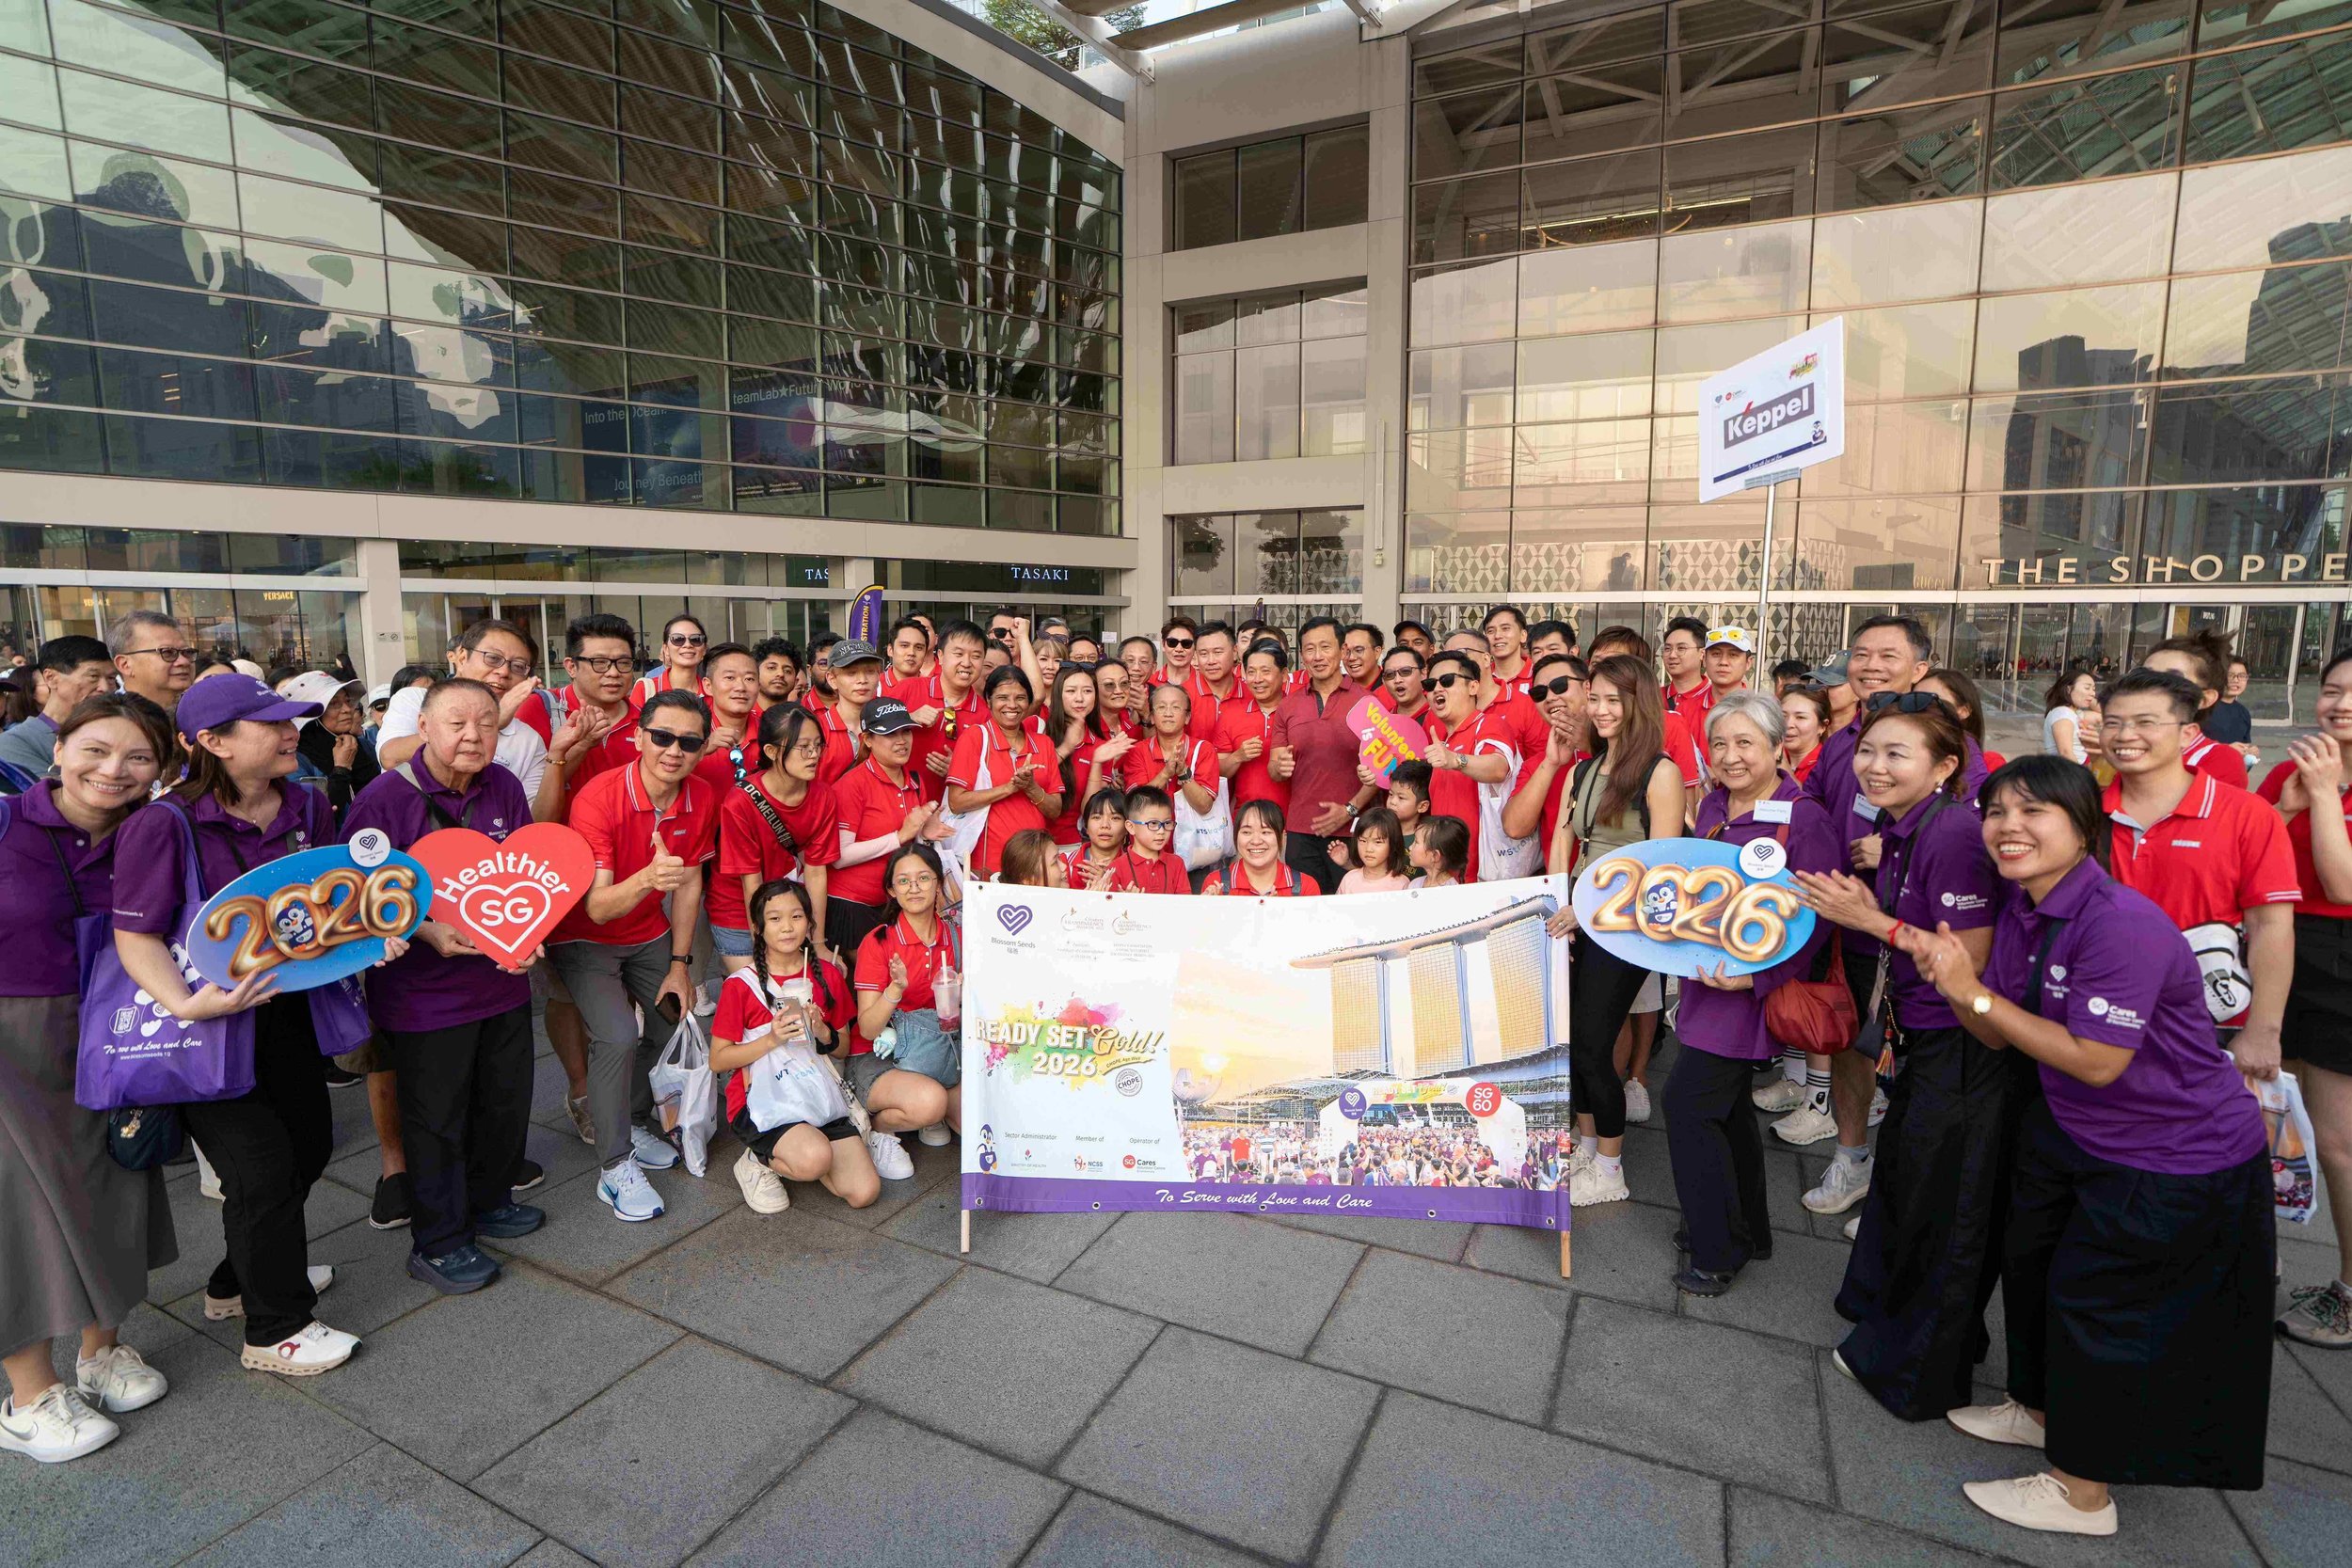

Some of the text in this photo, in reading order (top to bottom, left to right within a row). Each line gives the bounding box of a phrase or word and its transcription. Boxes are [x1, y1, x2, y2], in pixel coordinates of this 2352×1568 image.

[585, 412, 605, 424] Into
[607, 408, 626, 421] the
[1727, 388, 1810, 442] Keppel
[614, 478, 656, 491] Jouney
[1010, 567, 1069, 580] TASAKI
[1981, 553, 2348, 584] THE SHOPPE
[263, 592, 294, 600] VERSACE
[1361, 727, 1375, 741] is
[1367, 702, 1421, 762] Voluntee
[434, 851, 570, 903] Healthier
[480, 897, 533, 927] SG
[1590, 857, 1799, 962] 2026
[204, 865, 417, 981] 2026
[991, 936, 1017, 946] Blossom
[2108, 1006, 2137, 1018] Cares
[975, 1018, 1164, 1055] READY SET Gold!
[103, 1045, 116, 1054] To
[143, 1040, 161, 1051] Love
[163, 1039, 181, 1049] and
[183, 1037, 202, 1049] Care
[1033, 1051, 1098, 1077] 2026
[1118, 1076, 1140, 1089] CHOPE
[1473, 1087, 1493, 1099] SG
[1472, 1100, 1492, 1112] 60
[1154, 1189, 1374, 1209] To Serve with Love and Care
